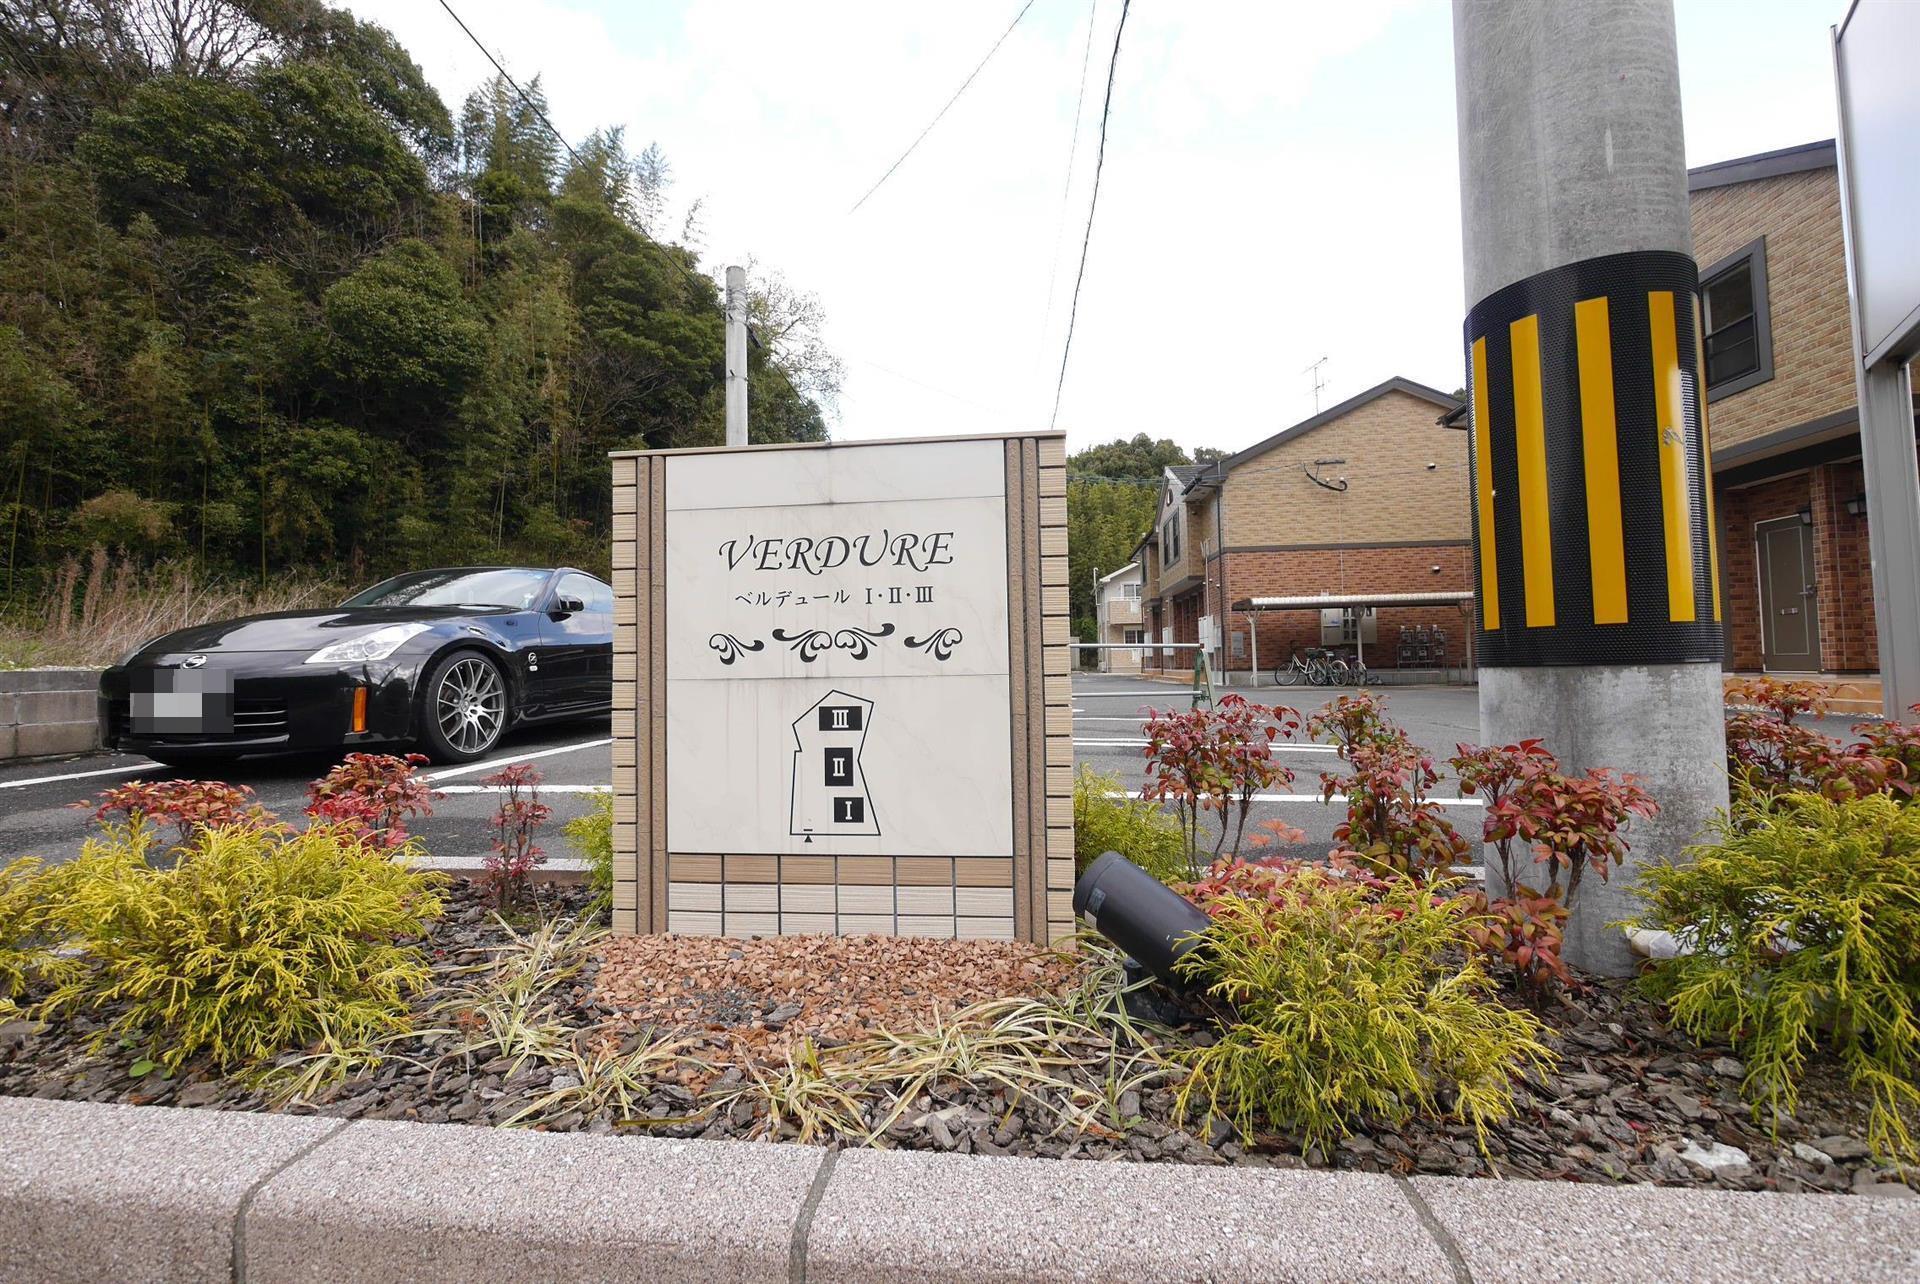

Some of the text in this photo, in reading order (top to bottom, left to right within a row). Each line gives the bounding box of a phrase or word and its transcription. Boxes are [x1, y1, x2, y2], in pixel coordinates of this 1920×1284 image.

[718, 528, 954, 576] VERDURE
[735, 588, 851, 608] ベルデュール
